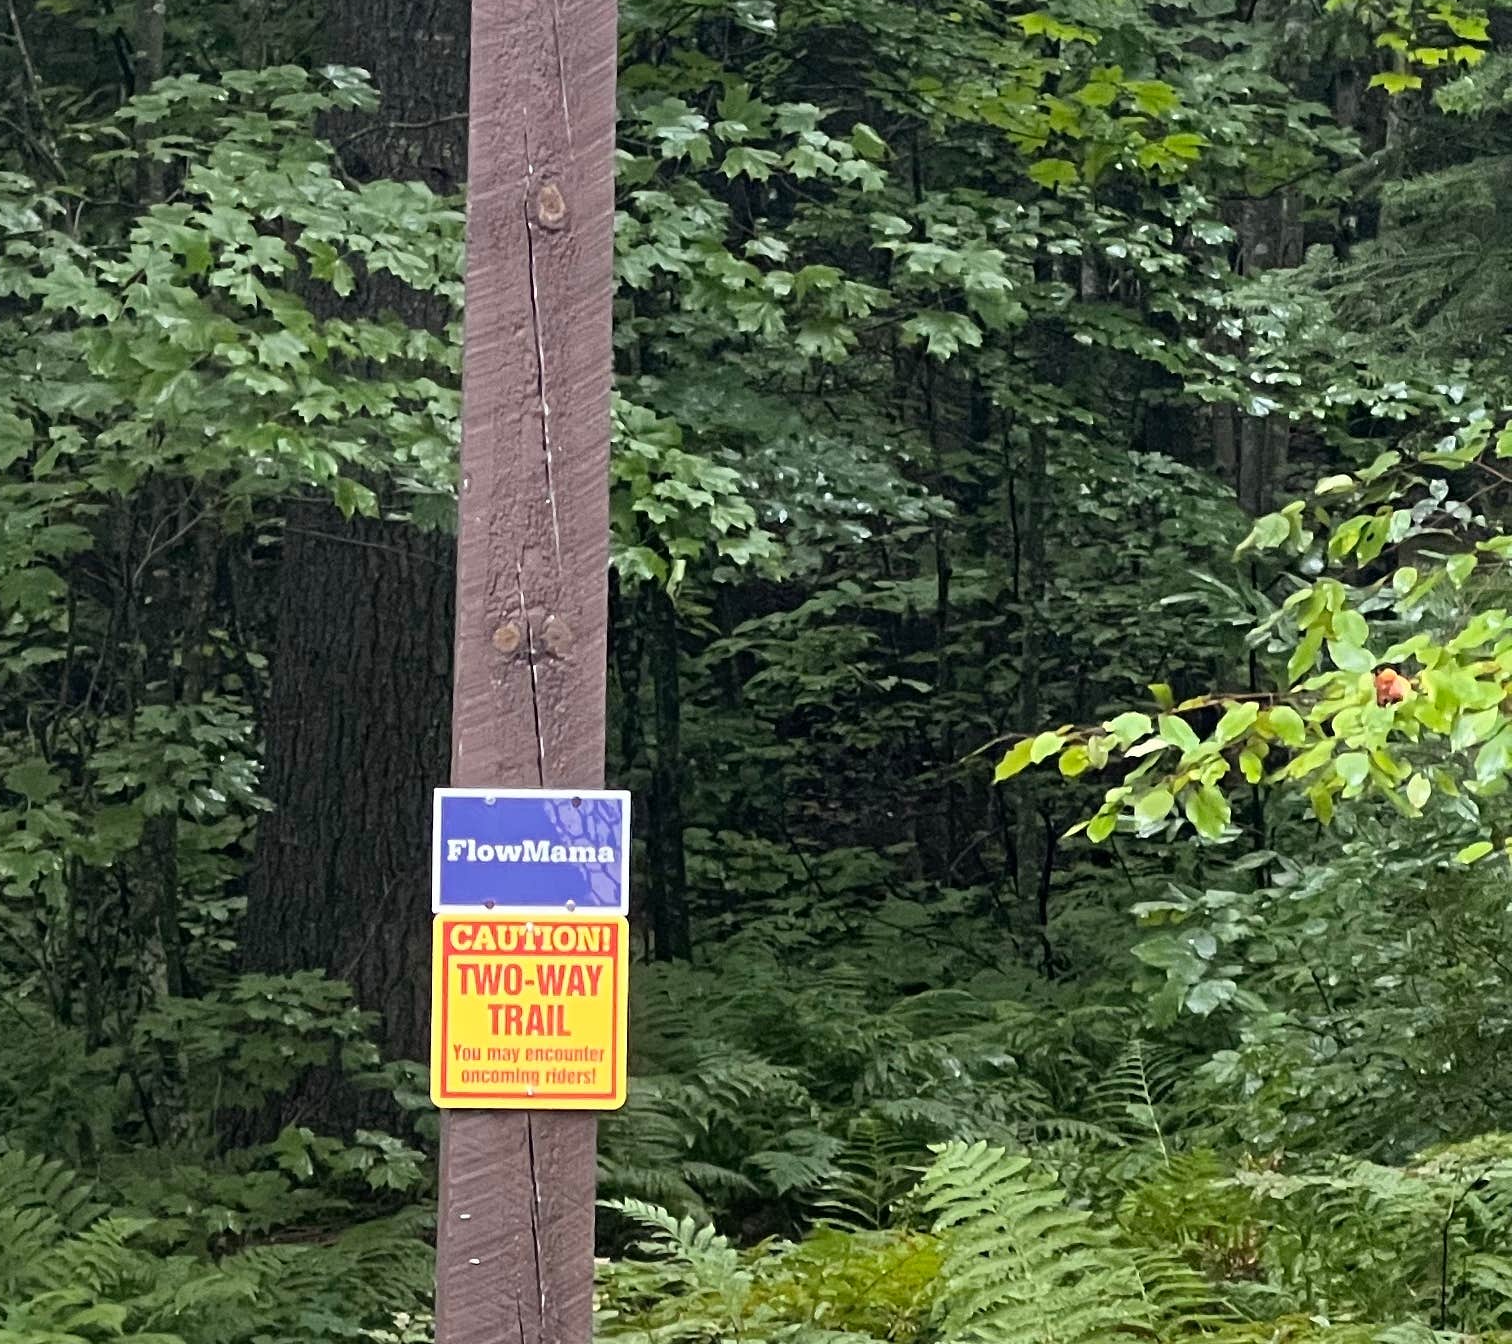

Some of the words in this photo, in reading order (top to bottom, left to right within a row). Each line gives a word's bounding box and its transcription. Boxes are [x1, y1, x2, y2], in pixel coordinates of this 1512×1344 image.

[446, 839, 615, 863] FlowMama
[449, 924, 611, 952] CAUTION!
[456, 963, 604, 996] TWO-WAY
[487, 1004, 572, 1037] TRAIL
[453, 1043, 481, 1062] You
[487, 1046, 520, 1064] may
[525, 1045, 605, 1062] encounter
[461, 1067, 540, 1086] oncoming
[545, 1067, 596, 1084] riders!
